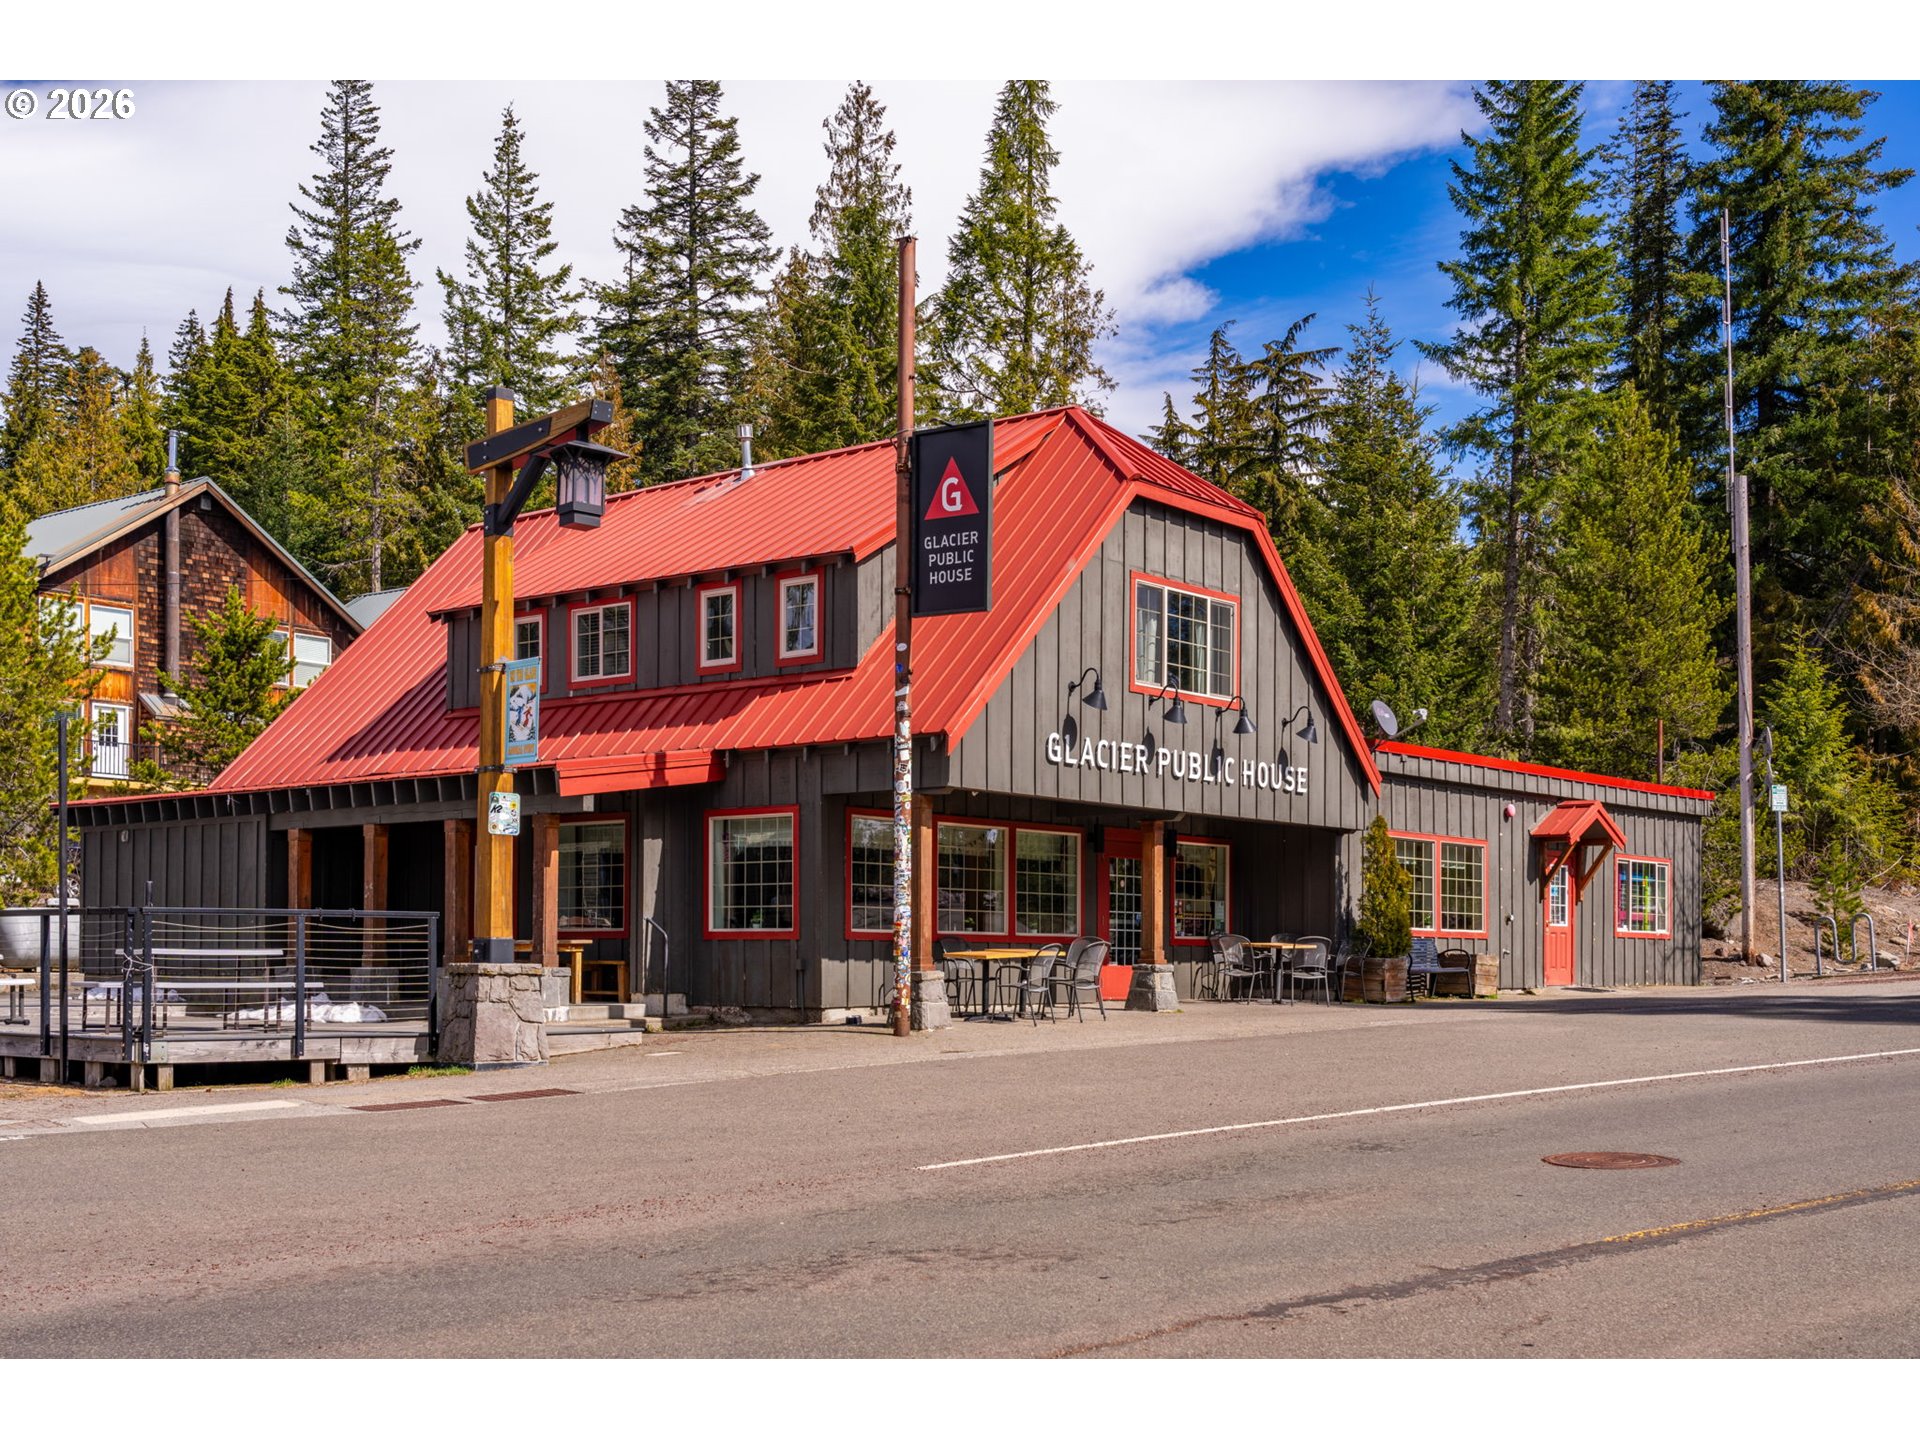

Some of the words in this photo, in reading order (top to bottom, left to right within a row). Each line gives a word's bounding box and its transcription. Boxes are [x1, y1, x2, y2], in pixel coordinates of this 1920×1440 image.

[941, 477, 963, 512] G
[924, 531, 979, 549] GLACIER
[928, 549, 974, 567] PUBLIC
[929, 567, 972, 584] HOUSE
[1047, 732, 1149, 774] GLACIER
[1157, 747, 1235, 784] PUBLIC
[1242, 758, 1308, 793] HOUSE
